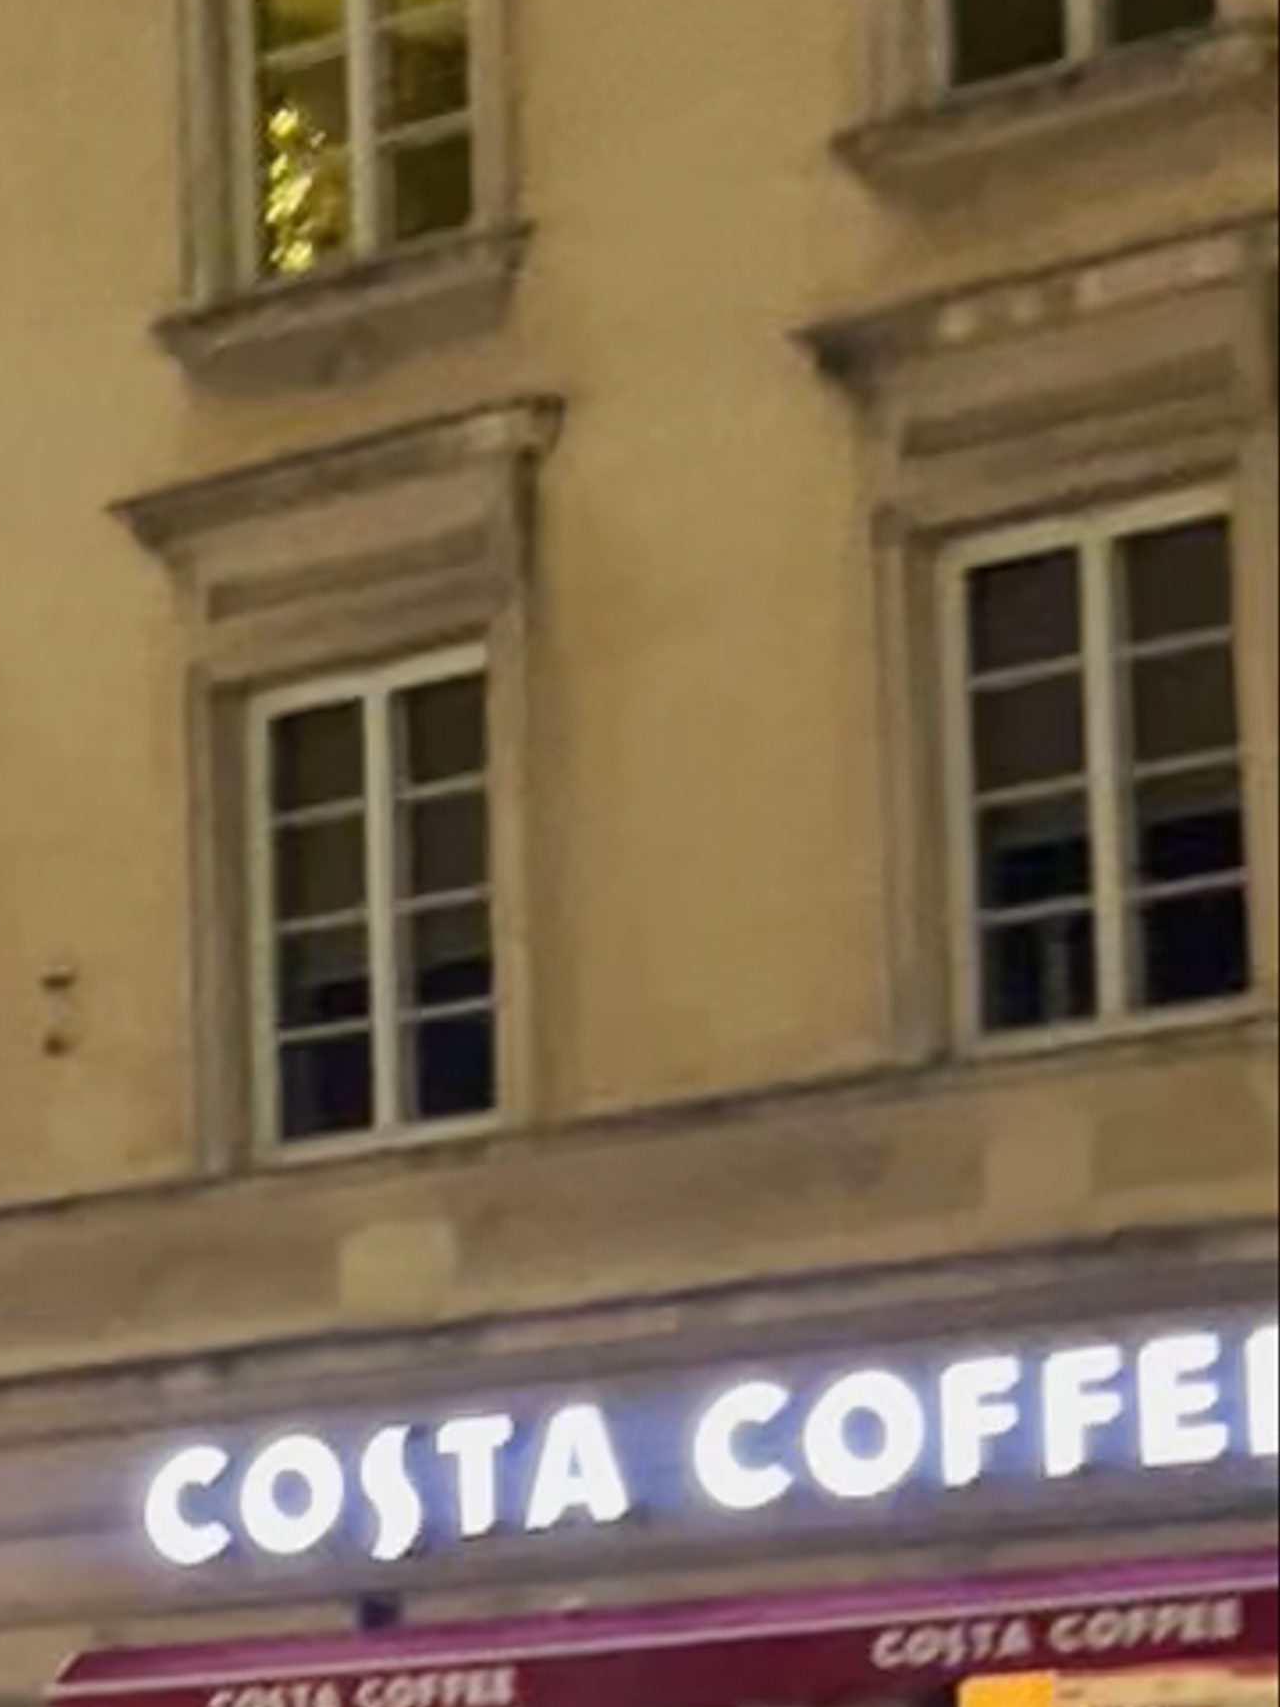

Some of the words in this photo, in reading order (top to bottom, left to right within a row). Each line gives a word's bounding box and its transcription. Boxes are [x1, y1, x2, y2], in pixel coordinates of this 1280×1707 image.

[144, 1402, 630, 1566] COSTA
[870, 1618, 1032, 1669] COSTA
[1049, 1598, 1240, 1653] COFFEE
